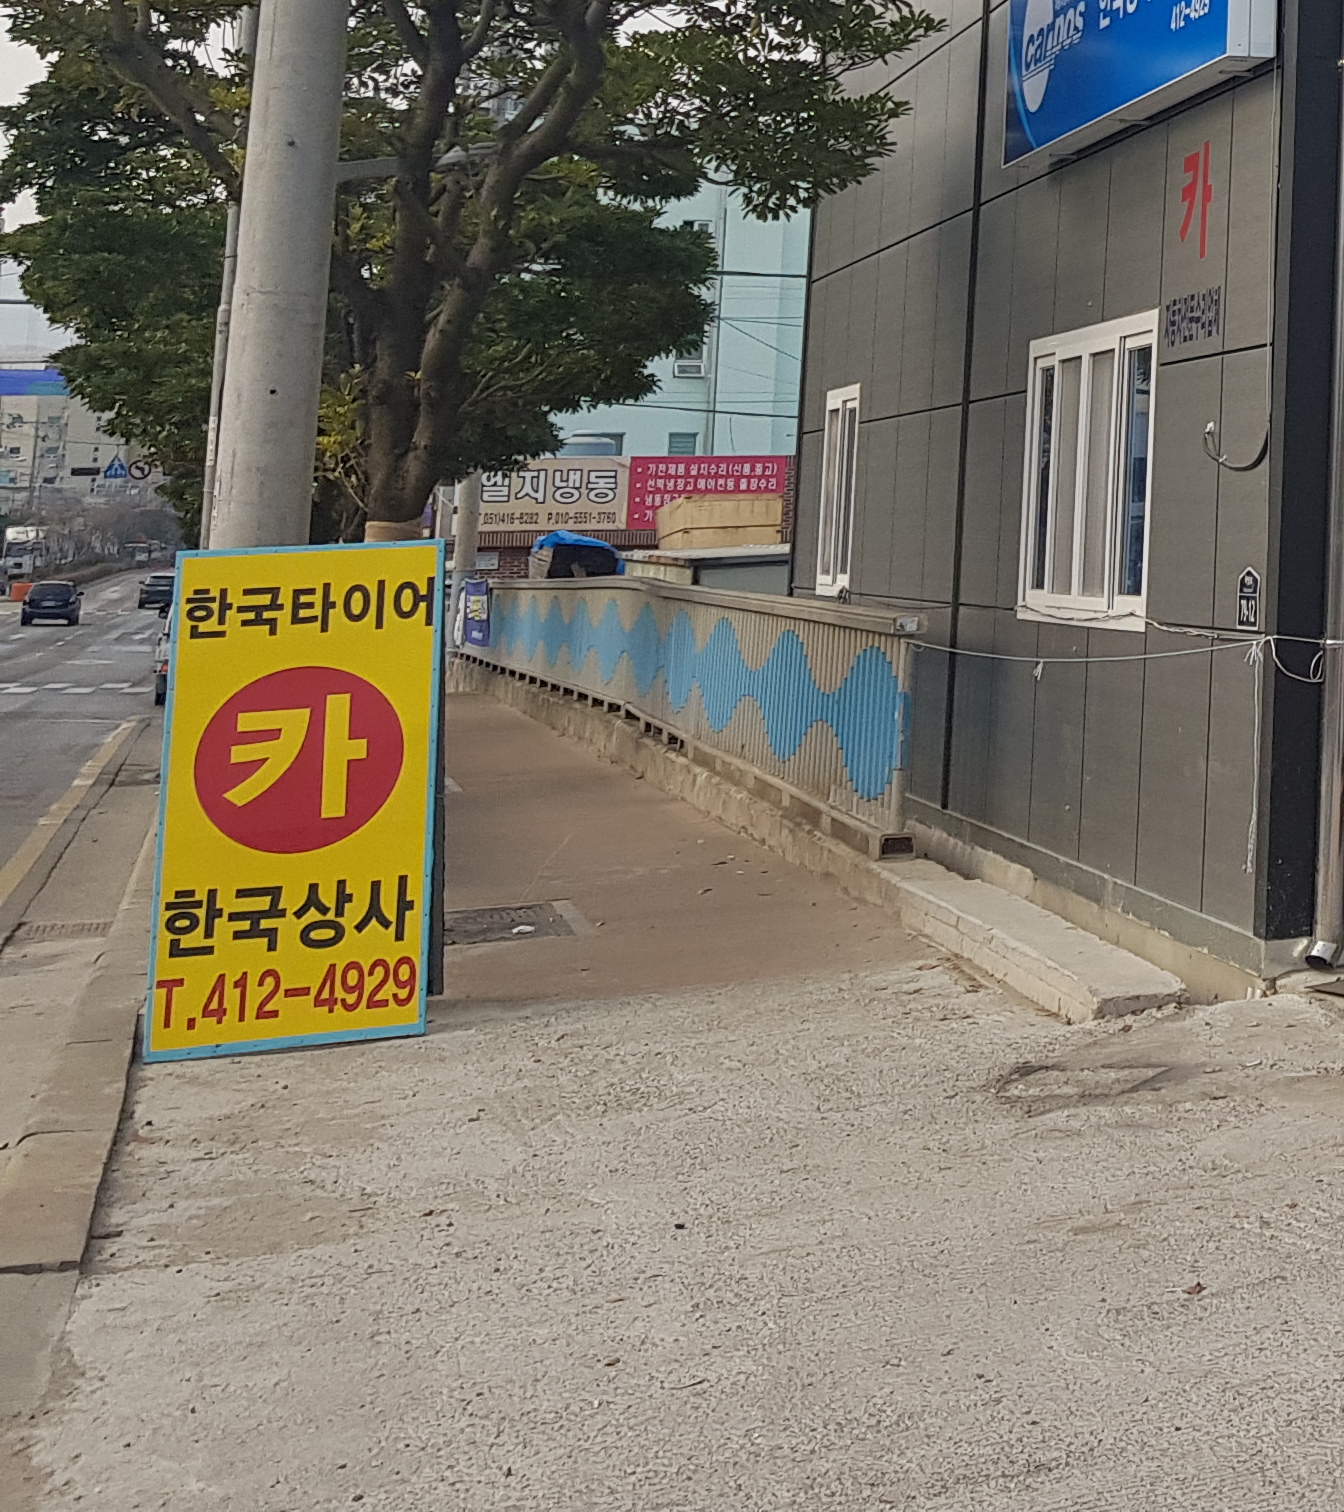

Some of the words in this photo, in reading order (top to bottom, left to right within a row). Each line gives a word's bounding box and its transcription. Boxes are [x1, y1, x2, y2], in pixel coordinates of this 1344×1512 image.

[1178, 140, 1213, 259] 카
[480, 468, 618, 505] 엘지냉동
[184, 576, 435, 640] 한국타이어
[222, 692, 368, 819] 카
[163, 874, 416, 959] 한국상사
[155, 955, 417, 1031] T.412-4929
